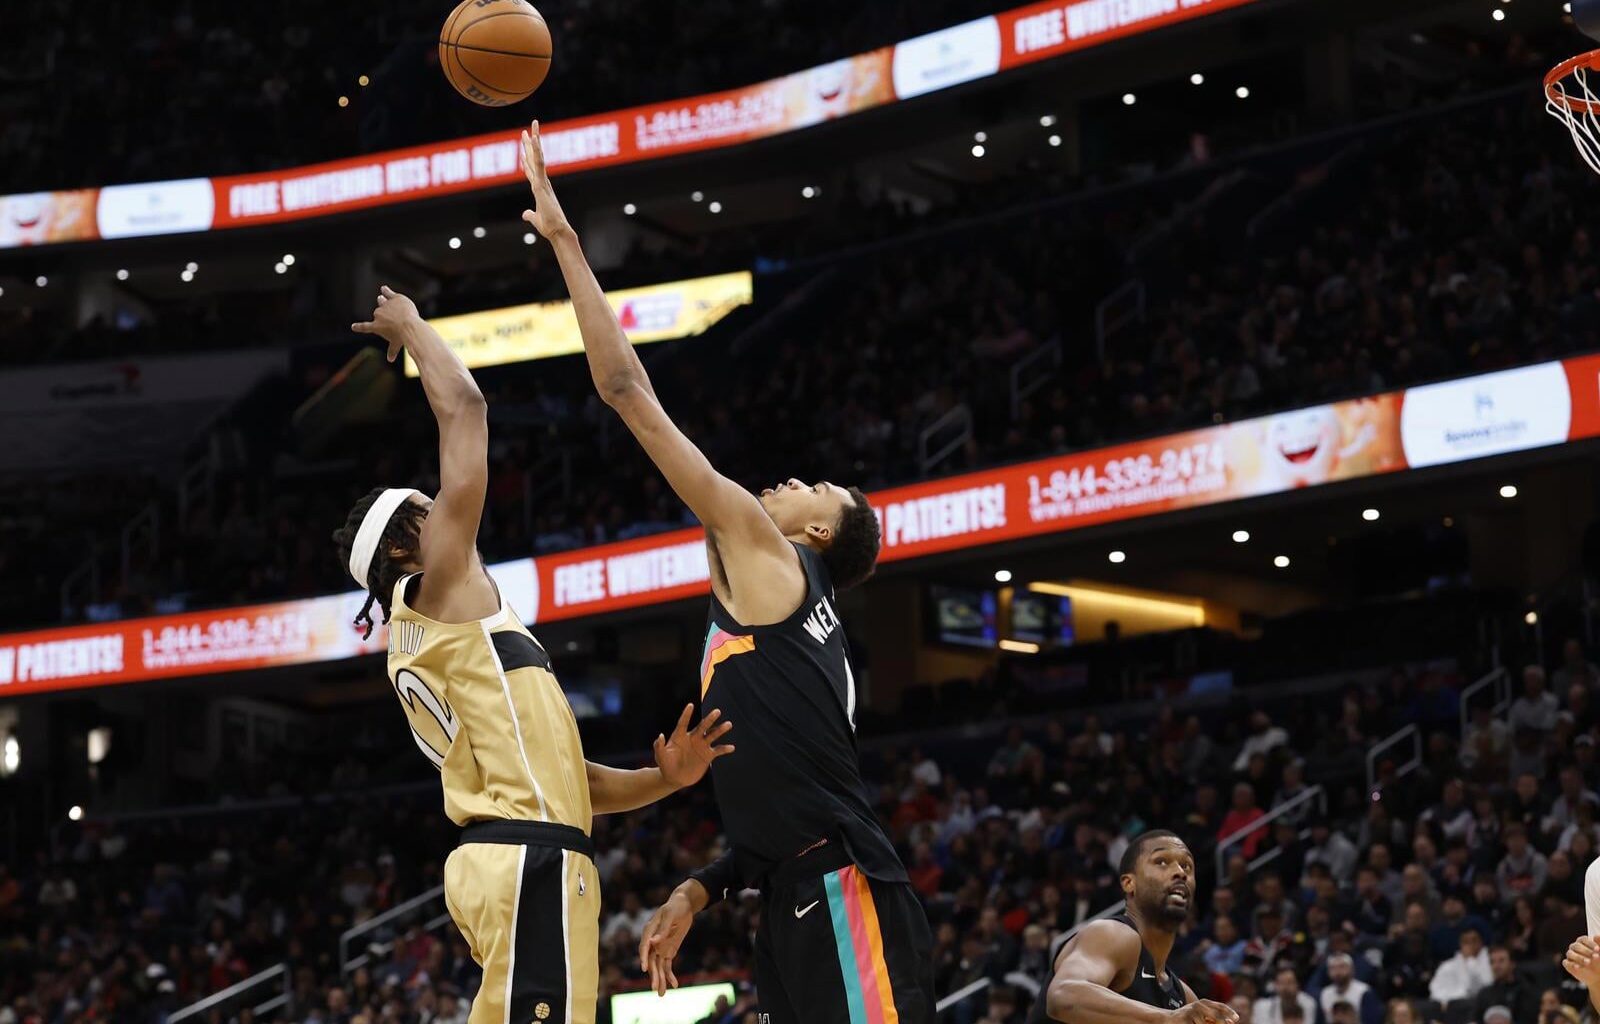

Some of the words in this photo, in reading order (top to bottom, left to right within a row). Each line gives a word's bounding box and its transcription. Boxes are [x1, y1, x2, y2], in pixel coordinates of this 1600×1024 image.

[1014, 9, 1065, 55] FREE
[886, 482, 1007, 547] PATIENTS!
[553, 559, 606, 608] FREE
[17, 633, 124, 683] PATIENTS!
